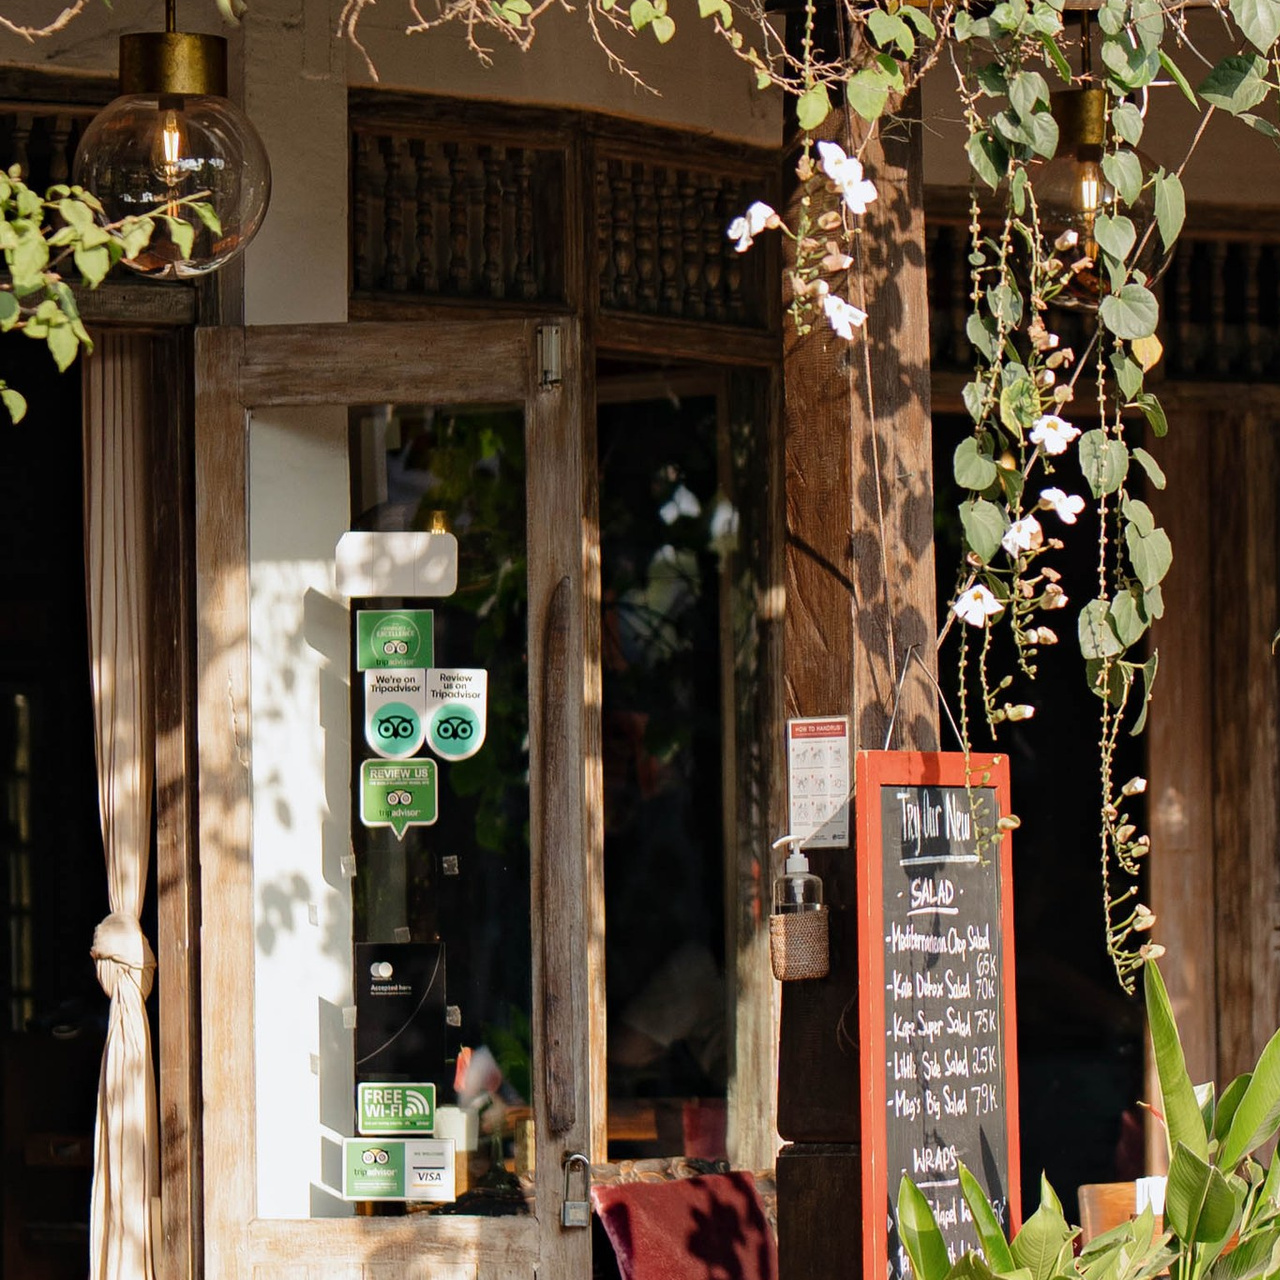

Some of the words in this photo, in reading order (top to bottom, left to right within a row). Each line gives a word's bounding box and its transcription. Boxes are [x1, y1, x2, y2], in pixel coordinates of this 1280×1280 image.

[375, 675, 402, 684] We're
[440, 673, 473, 682] Review
[370, 683, 420, 694] Tripadvisor
[443, 682, 454, 690] us
[431, 690, 481, 699] Tripadvisor
[370, 769, 411, 779] REVIEW
[414, 768, 429, 778] US
[922, 788, 943, 839] Our
[946, 793, 970, 841] New
[911, 877, 955, 908] SALAD
[967, 923, 990, 952] Salad
[945, 969, 971, 999] Salad
[946, 1006, 972, 1037] Salad
[922, 1050, 942, 1081] Side
[944, 1046, 969, 1078] Salad
[972, 1045, 998, 1074] 25K
[364, 1089, 403, 1104] FREE
[925, 1089, 941, 1121] Big
[942, 1084, 968, 1117] Salad
[971, 1083, 998, 1117] 79K
[365, 1103, 403, 1118] WI-FI
[913, 1144, 960, 1174] WRAPS
[418, 1172, 442, 1181] VISA
